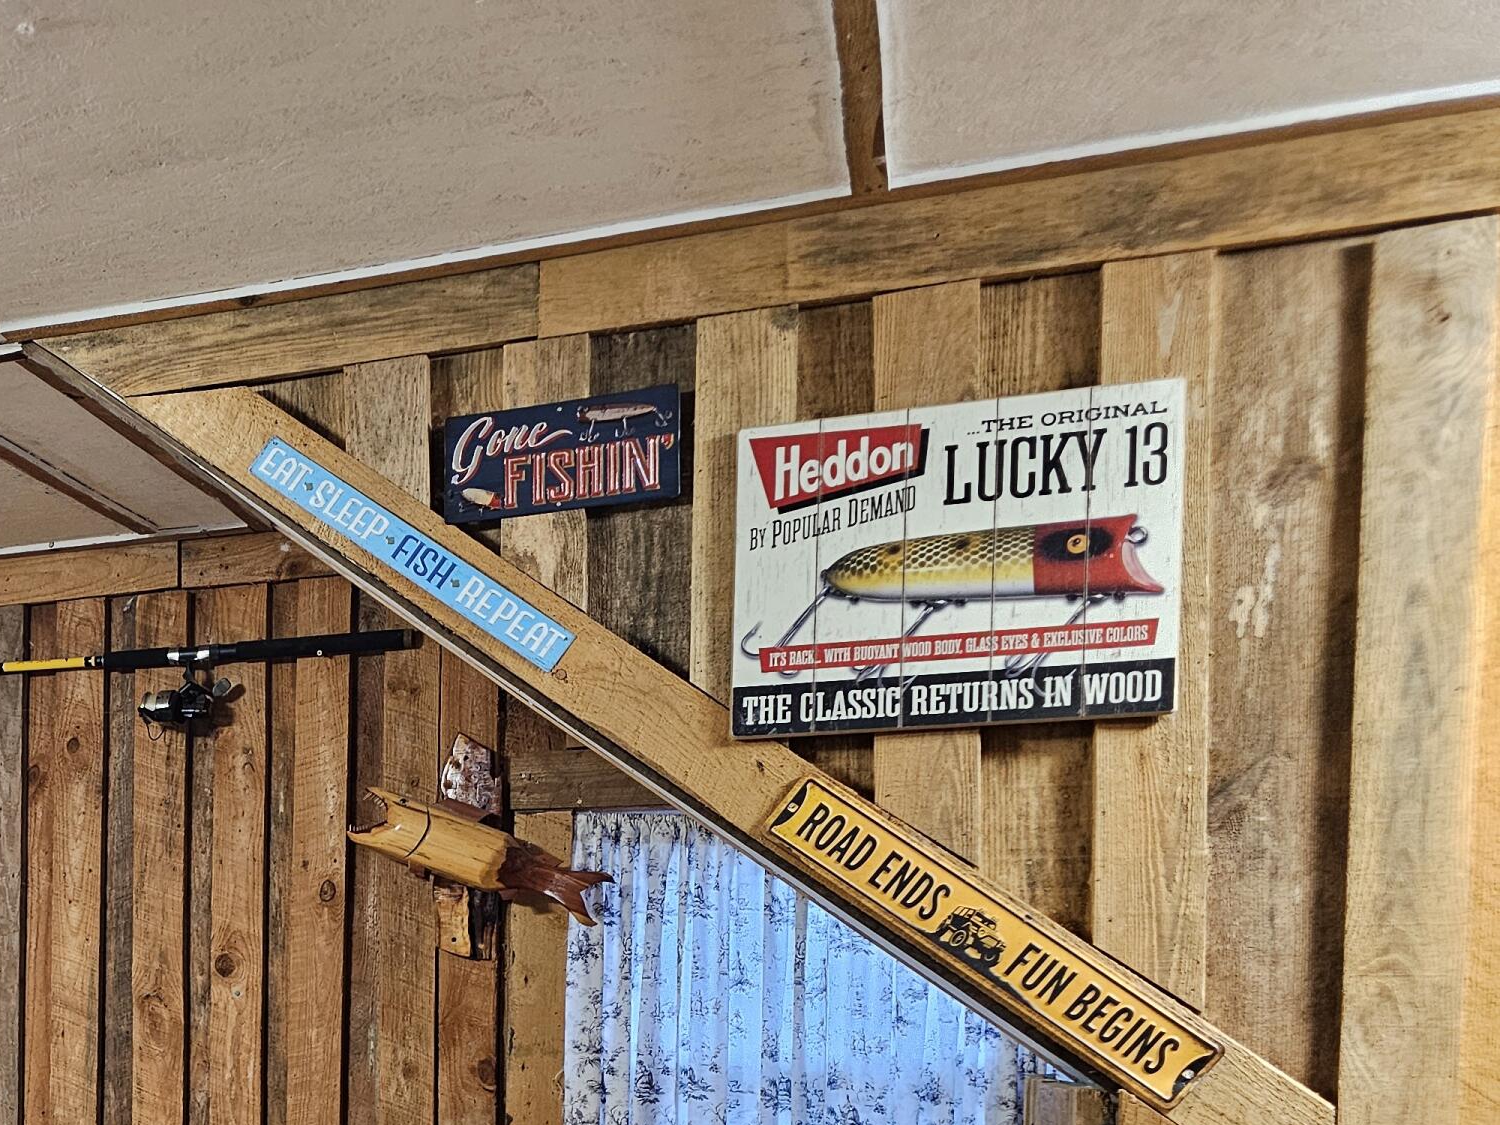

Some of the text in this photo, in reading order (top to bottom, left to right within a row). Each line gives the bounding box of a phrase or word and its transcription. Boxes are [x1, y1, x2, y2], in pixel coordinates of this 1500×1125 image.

[1041, 401, 1168, 427] ORIGINAL
[451, 416, 573, 485] Gone
[503, 433, 675, 509] FISHIN'
[774, 436, 914, 500] Heddon
[943, 421, 1169, 505] LUCKY 13
[258, 446, 568, 659] EAT SLEEP FISH REPEAT
[824, 646, 851, 664] WITH
[853, 643, 901, 662] BUOYANT
[902, 640, 931, 658] WOOD
[965, 635, 999, 653] GLASS
[1001, 631, 1030, 650] EYES
[1031, 632, 1040, 648] &
[1043, 624, 1103, 647] EXCLUSIVE
[1105, 624, 1149, 643] COLORS
[742, 669, 1163, 726] THE CLASSIC RETURNS IN WOOD
[797, 803, 1180, 1076] ROAD ENDS FUN BEGINS
